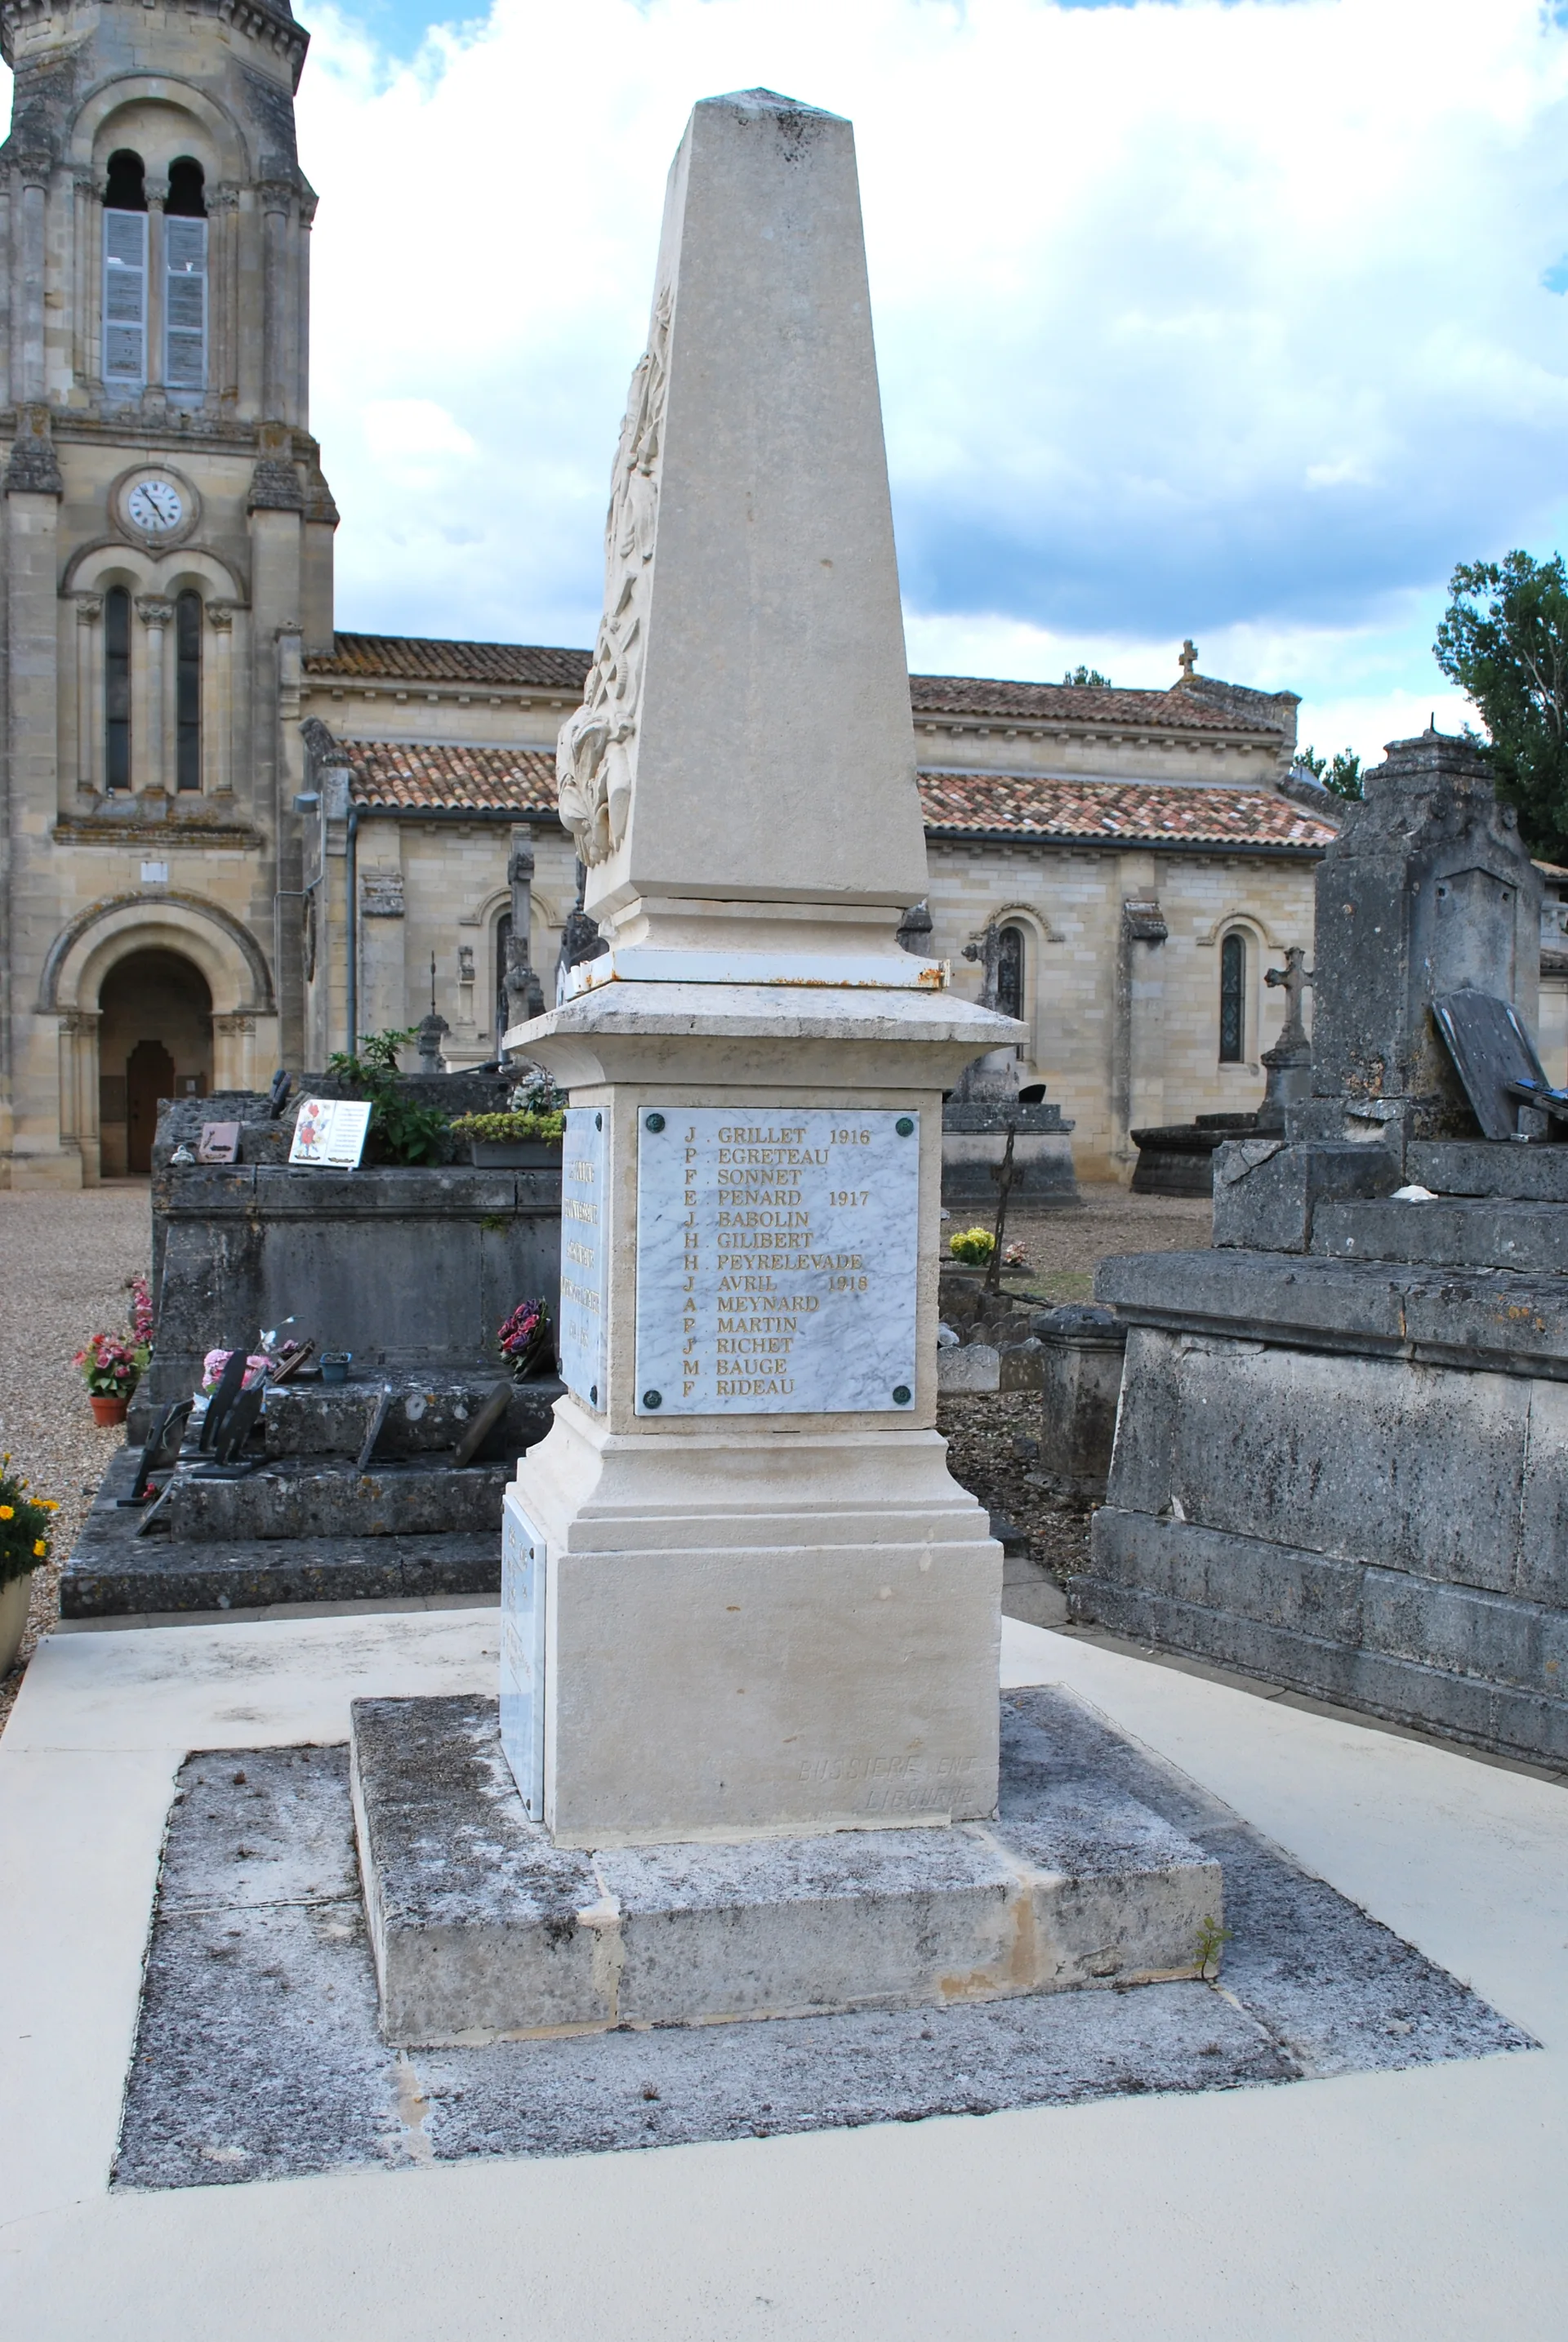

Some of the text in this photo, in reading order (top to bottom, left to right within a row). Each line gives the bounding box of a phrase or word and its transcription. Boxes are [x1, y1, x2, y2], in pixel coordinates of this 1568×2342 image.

[719, 1128, 806, 1144] GRILLET
[831, 1129, 870, 1145] 1916
[719, 1148, 829, 1165] EGRETEAU
[718, 1169, 802, 1185] SONNET
[718, 1190, 802, 1206] PENARD
[829, 1191, 869, 1207] 1917
[718, 1212, 810, 1227] BABOLIN
[718, 1232, 813, 1249] GILIBERT
[717, 1254, 863, 1271] PEYRELEVADE
[718, 1276, 777, 1292] AVRIL
[828, 1276, 868, 1292] 1918
[717, 1296, 820, 1312] MEYNARD
[717, 1316, 798, 1333] MARTIN
[717, 1338, 794, 1354] RICHET
[716, 1359, 787, 1375] BAUGE
[716, 1379, 795, 1396] RIDEAU
[865, 1785, 976, 1810] LIBOURNE
